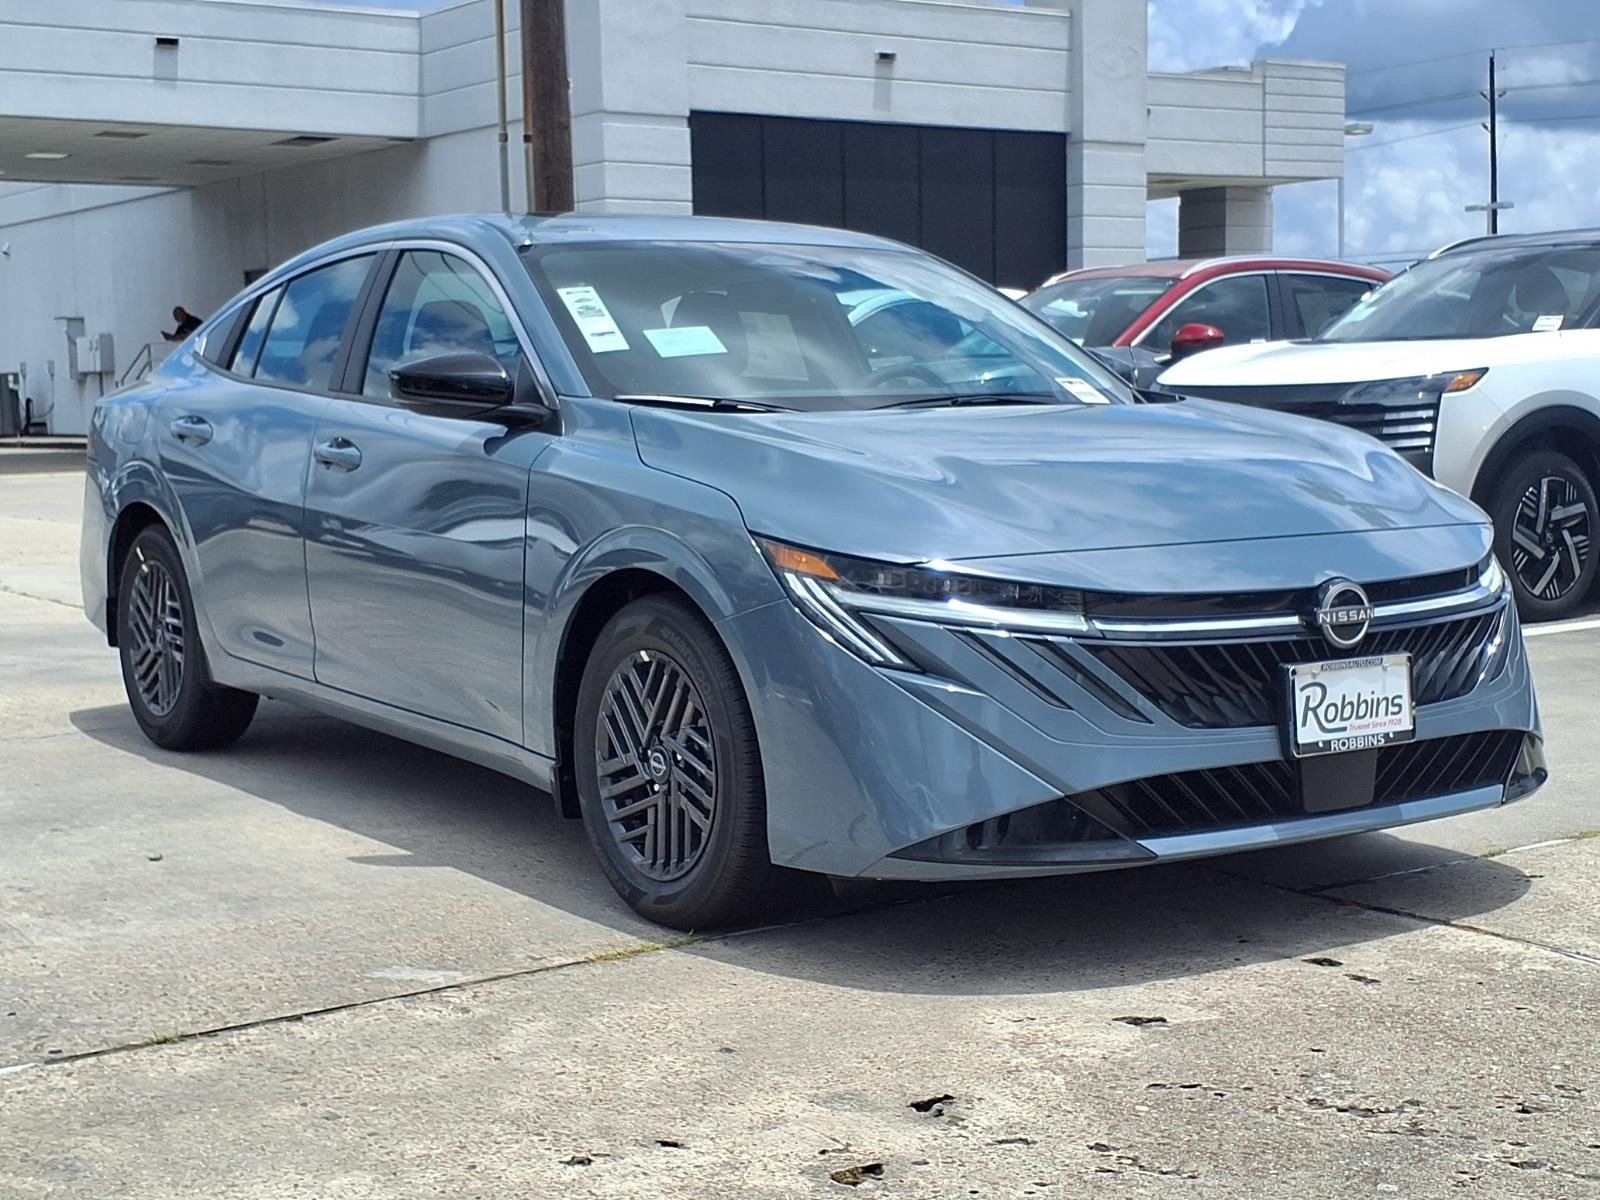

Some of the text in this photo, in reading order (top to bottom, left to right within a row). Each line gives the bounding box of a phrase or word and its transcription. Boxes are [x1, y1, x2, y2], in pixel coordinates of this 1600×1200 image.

[1320, 608, 1374, 623] NISSAN
[1300, 682, 1403, 734] Robbins
[1331, 734, 1385, 751] ROBBINS
